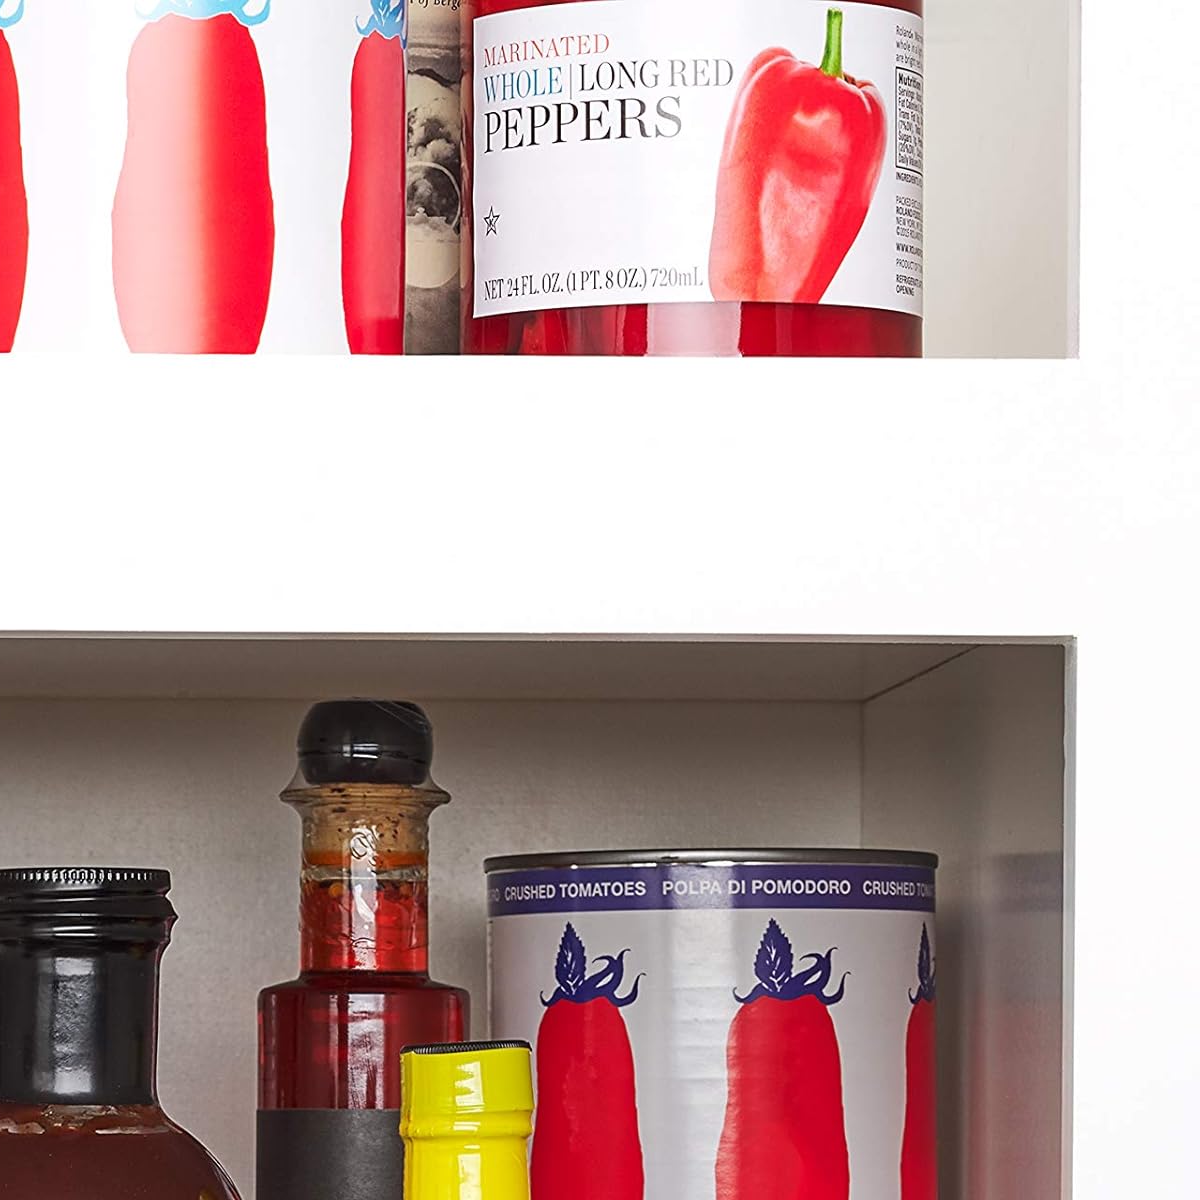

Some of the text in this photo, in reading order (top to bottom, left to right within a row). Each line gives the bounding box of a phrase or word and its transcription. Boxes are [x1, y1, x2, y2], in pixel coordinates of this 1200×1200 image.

[483, 33, 610, 68] MARINATED
[484, 59, 734, 104] WHOLE LONG RED
[484, 95, 682, 154] PEPPERS
[485, 278, 504, 301] NET
[507, 278, 519, 297] 24
[521, 275, 540, 296] FL.
[542, 272, 564, 294] OZ.
[581, 270, 602, 291] PT.
[605, 270, 614, 289] 8
[651, 266, 703, 288] 720mL
[504, 883, 556, 901] CRUSHED
[560, 880, 647, 898] TOMATOES
[662, 880, 722, 895] POLPA
[728, 880, 745, 894] DI
[752, 879, 851, 895] POMODORO
[862, 880, 915, 897] CRUSHED
